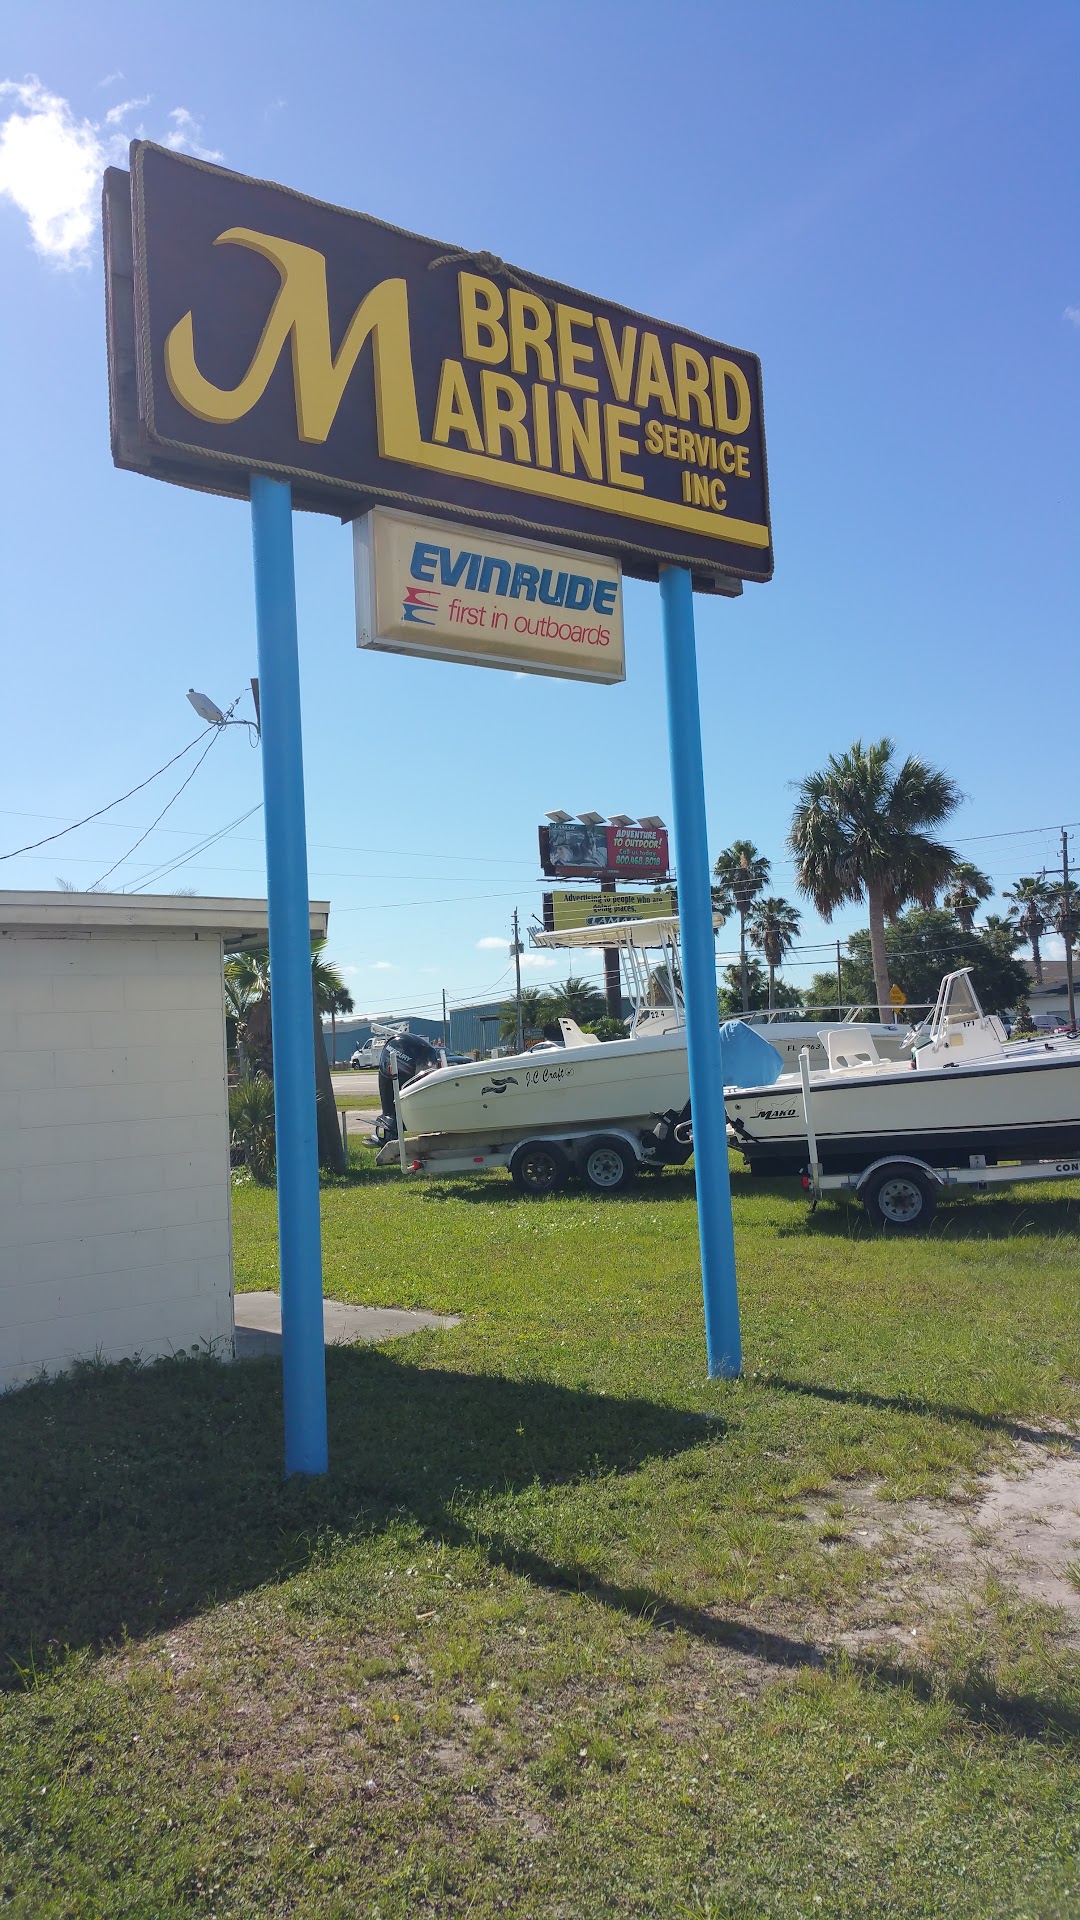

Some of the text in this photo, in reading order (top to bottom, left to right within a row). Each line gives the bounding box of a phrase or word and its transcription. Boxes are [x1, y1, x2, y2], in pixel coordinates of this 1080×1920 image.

[458, 271, 751, 435] BREVARD
[645, 419, 751, 478] SERVICE
[681, 470, 727, 511] INC
[410, 541, 618, 616] EVINRUDE
[448, 598, 610, 646] first in outboards
[616, 829, 657, 840] ADVENTURE
[613, 838, 662, 849] TO OUTDOOR!
[563, 894, 602, 903] Advertising
[612, 896, 635, 904] people
[593, 904, 612, 913] going
[542, 1067, 565, 1083] Craft
[750, 1109, 799, 1120] MAKO
